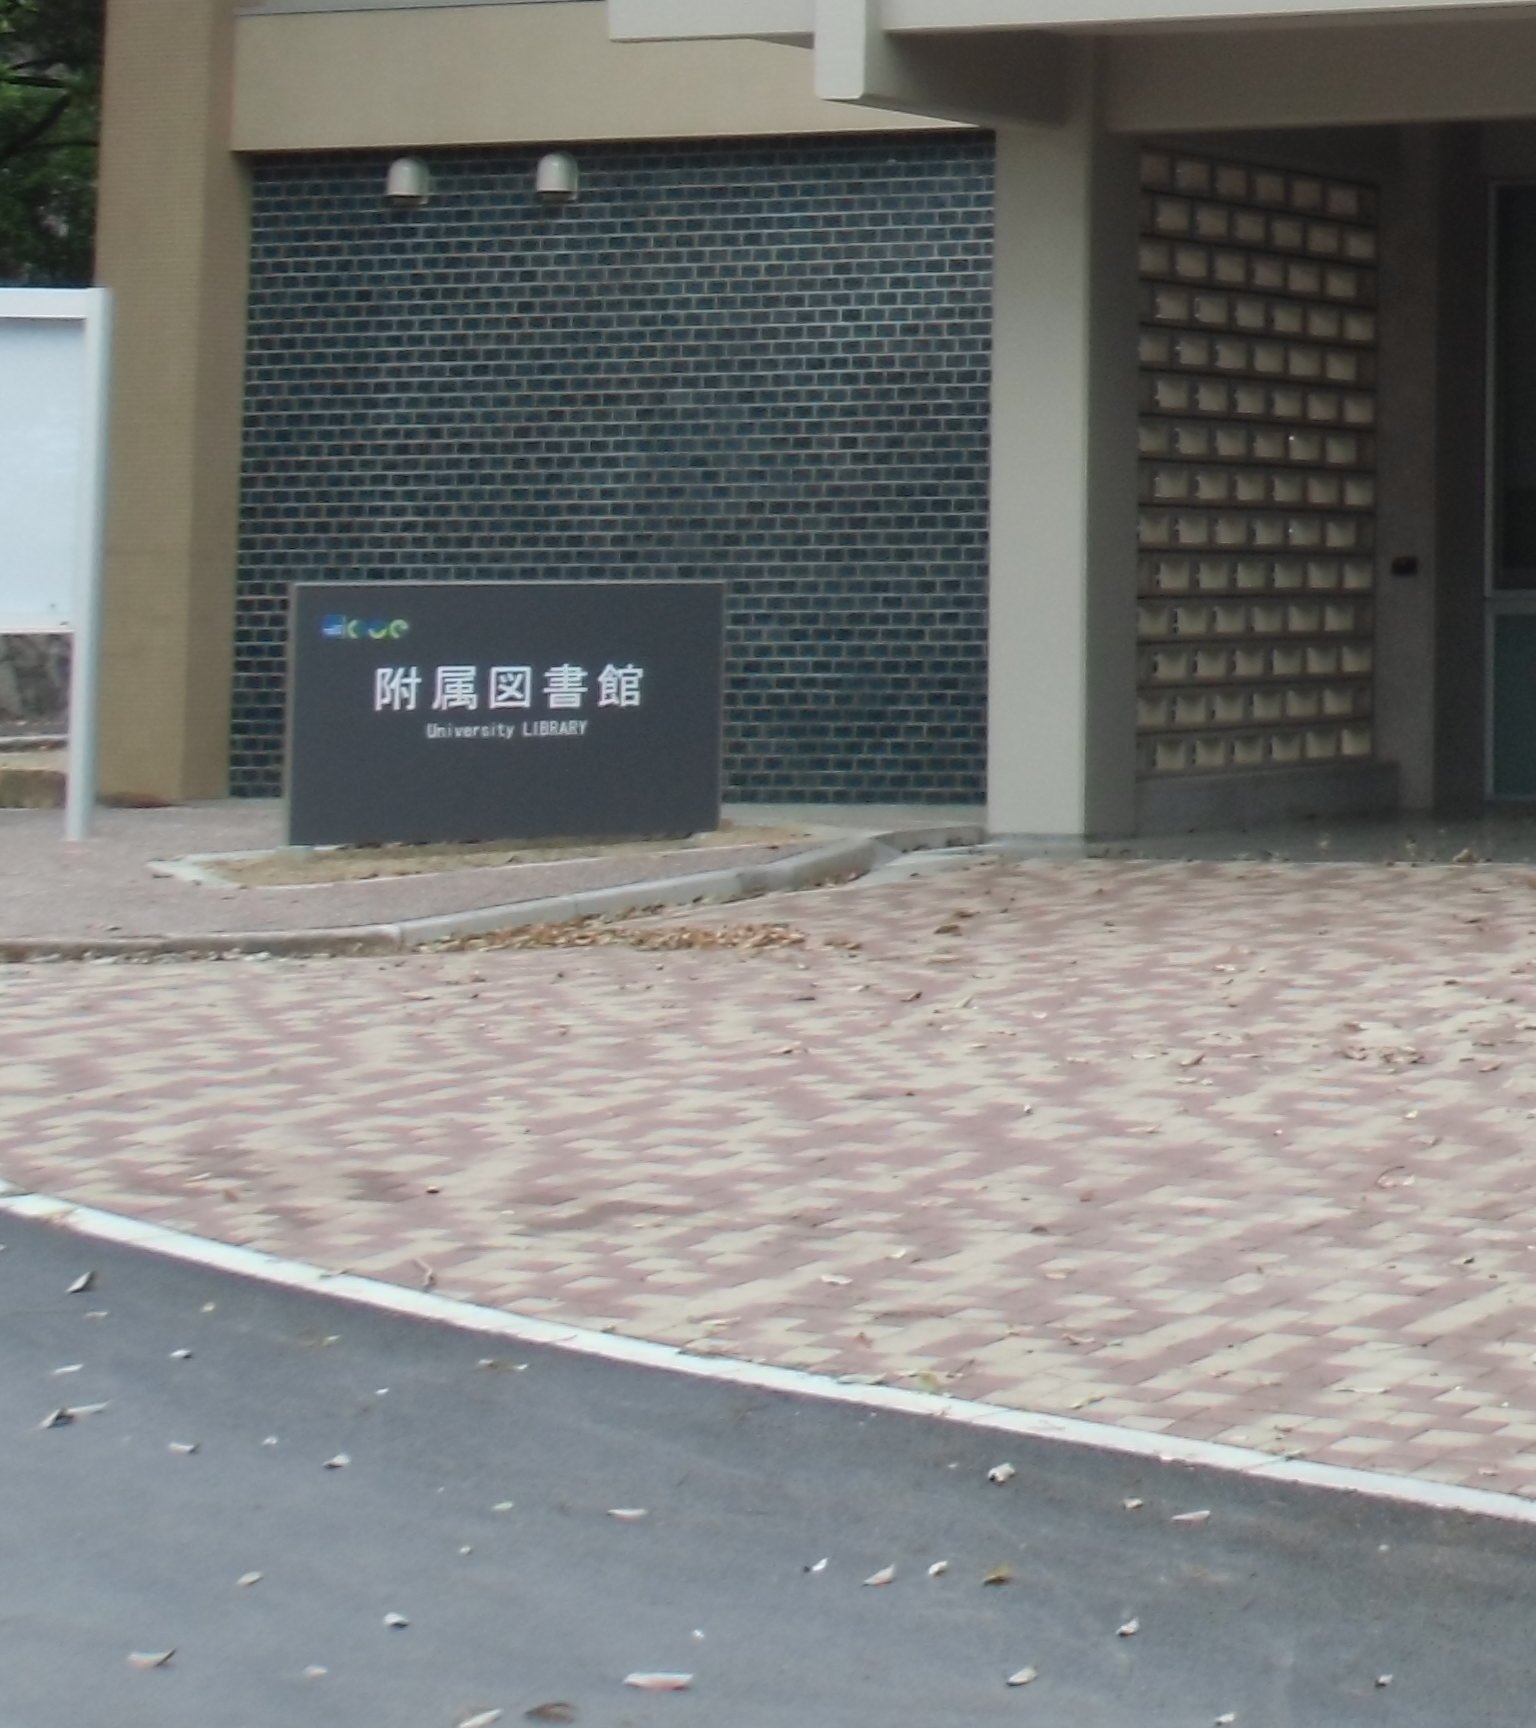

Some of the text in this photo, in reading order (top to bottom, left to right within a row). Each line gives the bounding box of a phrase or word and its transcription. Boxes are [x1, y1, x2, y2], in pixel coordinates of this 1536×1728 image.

[373, 662, 645, 712] 附属図書館
[426, 719, 588, 740] University LIBRARY
